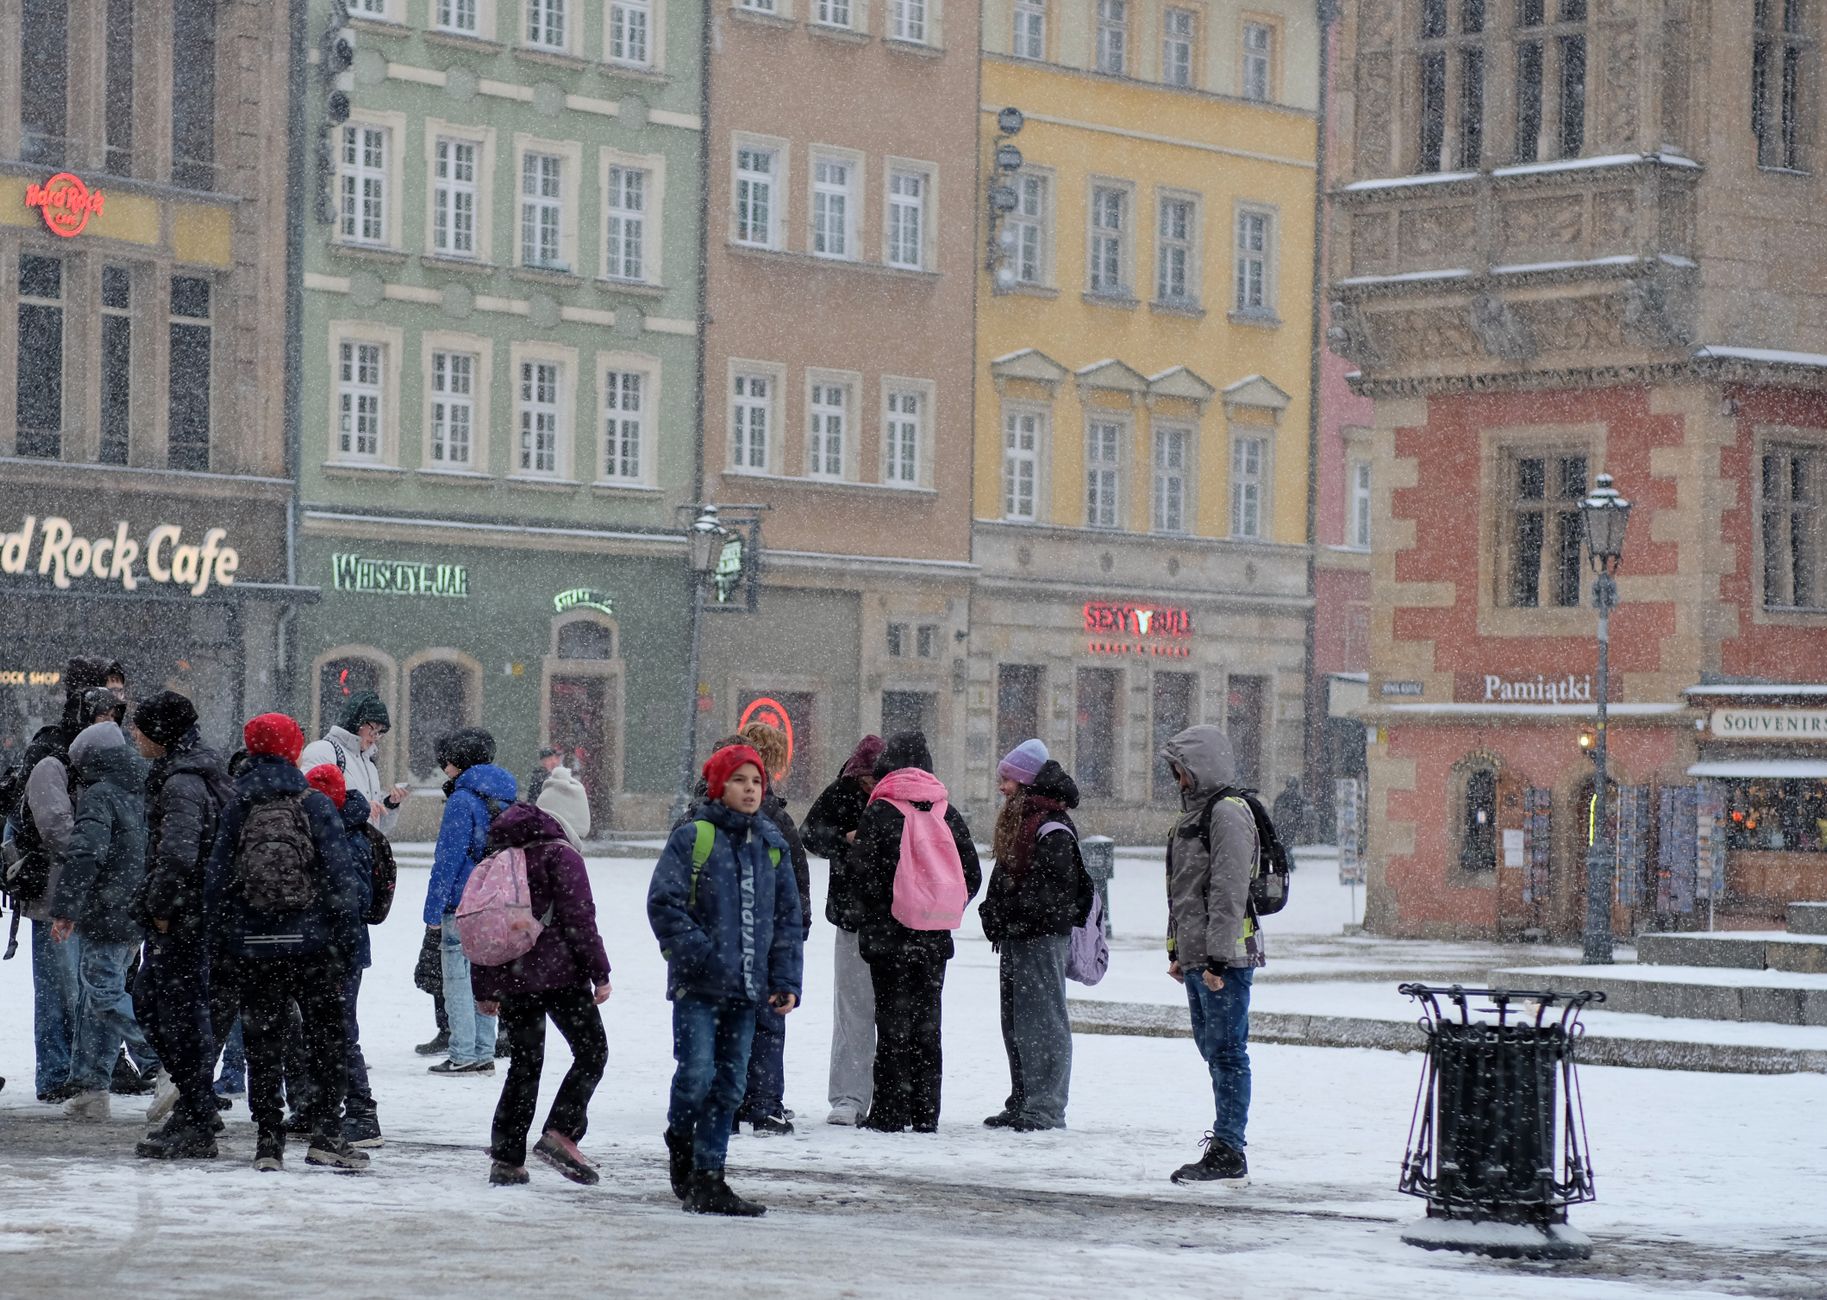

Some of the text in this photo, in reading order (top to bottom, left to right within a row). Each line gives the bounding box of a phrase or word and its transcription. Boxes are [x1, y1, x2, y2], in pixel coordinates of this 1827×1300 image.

[25, 184, 104, 216] Hard Rock
[38, 516, 140, 590] Rock
[147, 524, 240, 597] Cafe
[0, 671, 61, 686] OCK SHOP
[1484, 674, 1591, 704] Pamiątki
